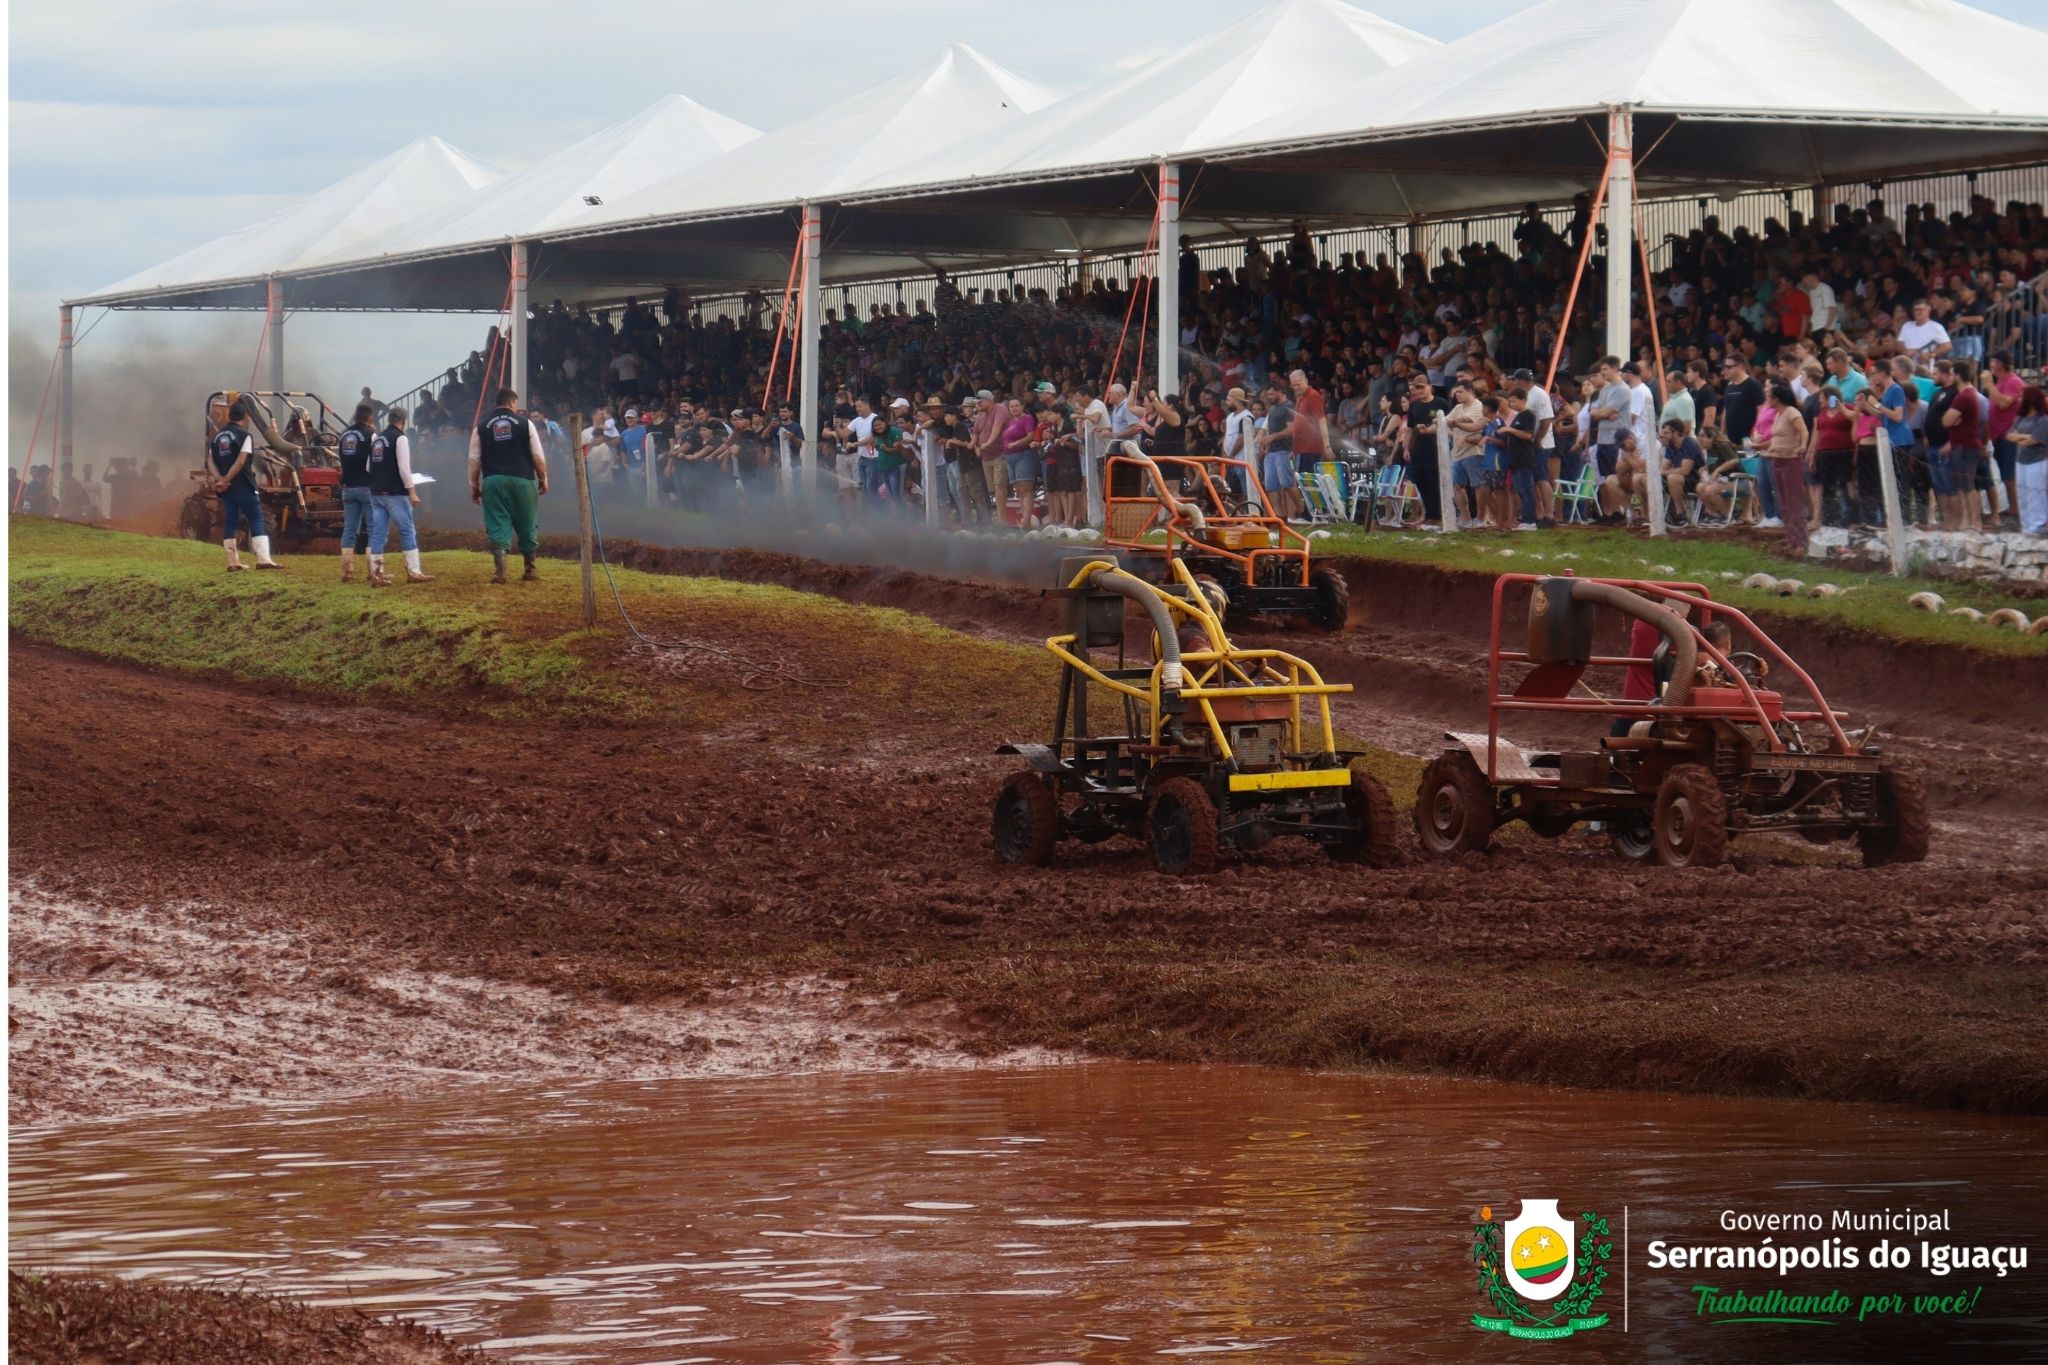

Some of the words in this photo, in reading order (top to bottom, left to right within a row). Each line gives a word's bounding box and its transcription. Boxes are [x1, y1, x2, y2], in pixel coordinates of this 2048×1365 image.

[1771, 758, 1807, 768] EQUIPE
[1810, 760, 1826, 769] NO
[1828, 760, 1857, 770] LIMITE
